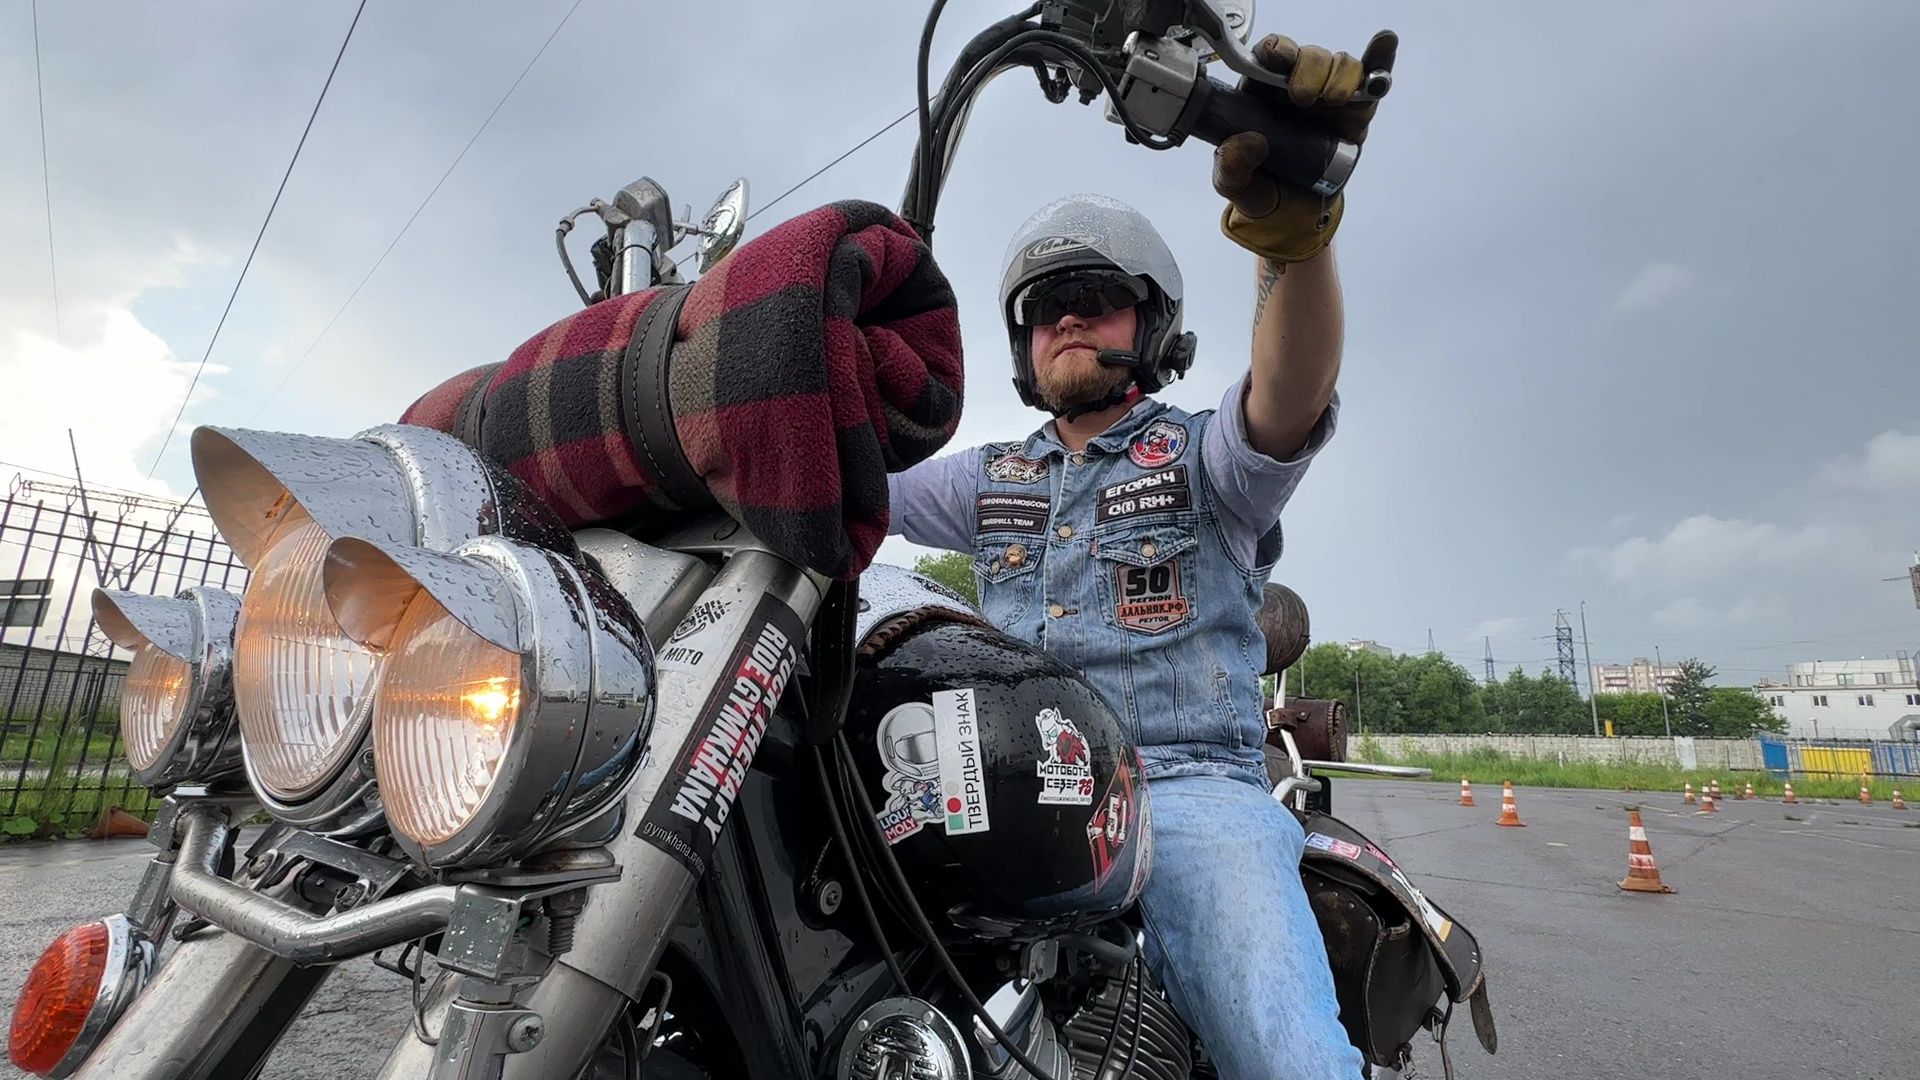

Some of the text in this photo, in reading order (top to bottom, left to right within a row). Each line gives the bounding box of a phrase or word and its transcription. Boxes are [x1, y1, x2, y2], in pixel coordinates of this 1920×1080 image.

[1105, 471, 1176, 499] ЕГОРЫЧ
[1125, 566, 1170, 597] 50
[1121, 602, 1183, 618] ДАЛЬНЯК.РФ
[669, 622, 789, 823] RIDE GYMKHANA
[956, 692, 971, 737] ЗНАК
[885, 817, 916, 840] MOLY
